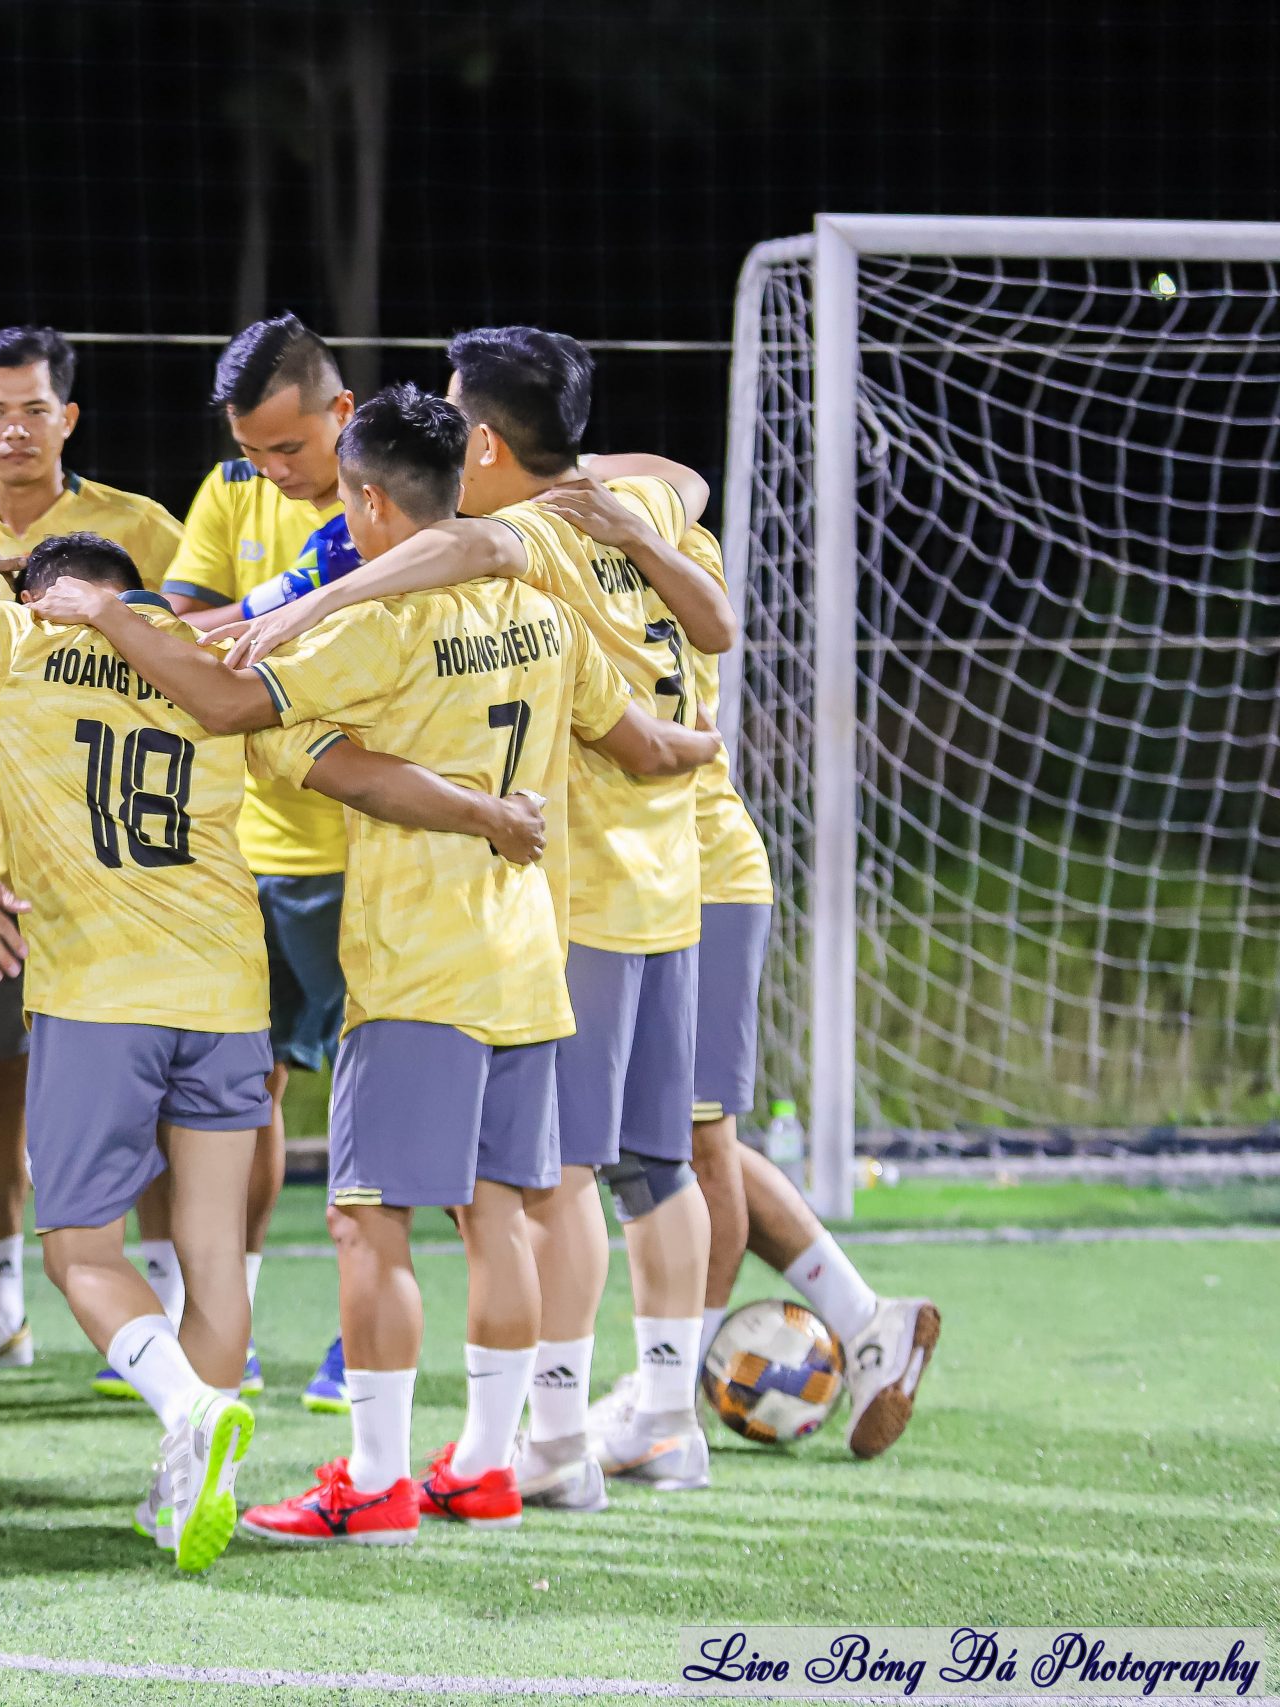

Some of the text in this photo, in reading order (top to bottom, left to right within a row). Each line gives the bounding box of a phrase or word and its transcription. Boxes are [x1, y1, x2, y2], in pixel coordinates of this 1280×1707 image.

[43, 645, 130, 697] HOÀNG
[538, 617, 561, 658] FC
[74, 718, 198, 869] 18
[488, 699, 533, 856] 7
